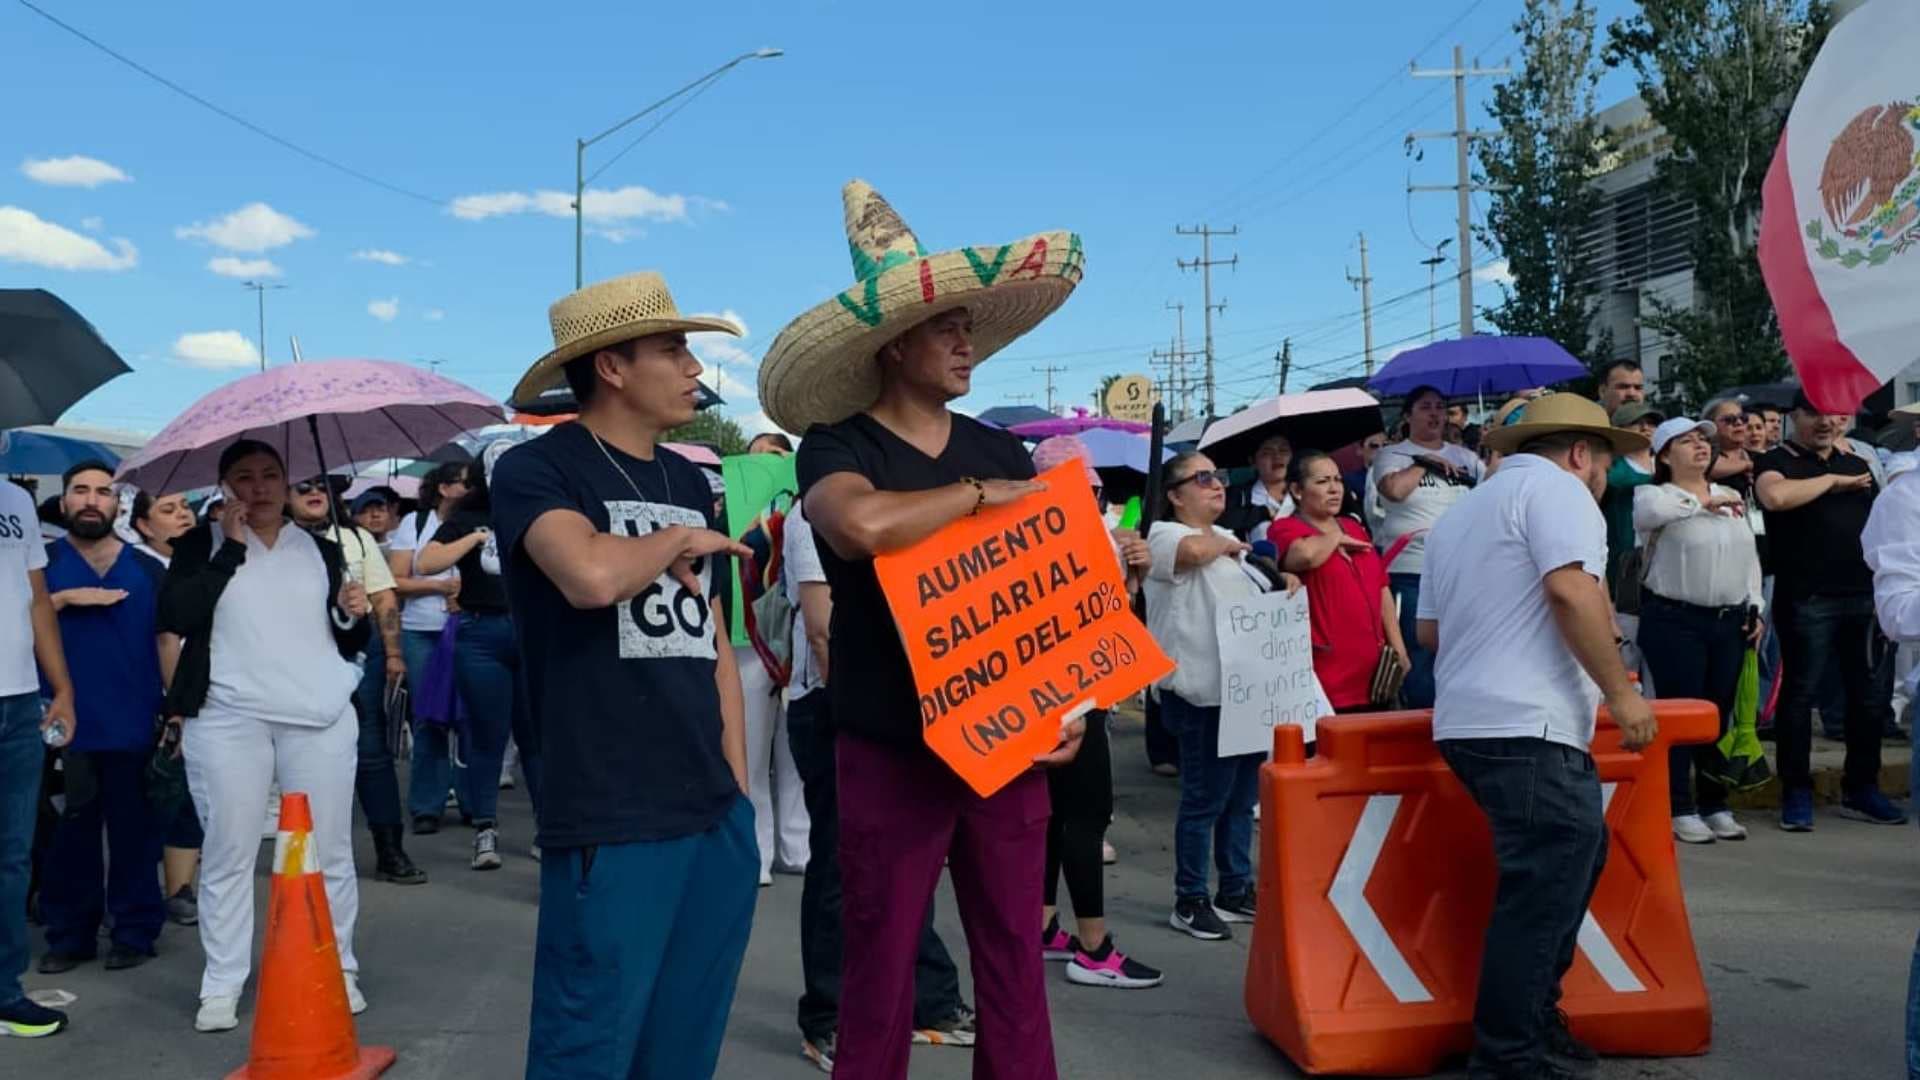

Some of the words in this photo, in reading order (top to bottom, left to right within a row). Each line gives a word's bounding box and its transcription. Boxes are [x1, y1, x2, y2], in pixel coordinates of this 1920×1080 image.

[837, 237, 1048, 326] VIVA
[917, 506, 1066, 607] AUMENTO
[630, 582, 708, 637] GO
[925, 552, 1088, 660] SALARIAL
[1230, 605, 1266, 634] Por
[1271, 607, 1287, 628] un
[921, 650, 1008, 726] DIGNO
[1014, 615, 1071, 666] DEL
[1077, 582, 1121, 629] 10%
[961, 704, 1026, 756] (NO
[1029, 681, 1074, 717] AL
[1067, 632, 1137, 690] 2.9%)
[1228, 673, 1256, 704] Por
[1265, 674, 1288, 697] un
